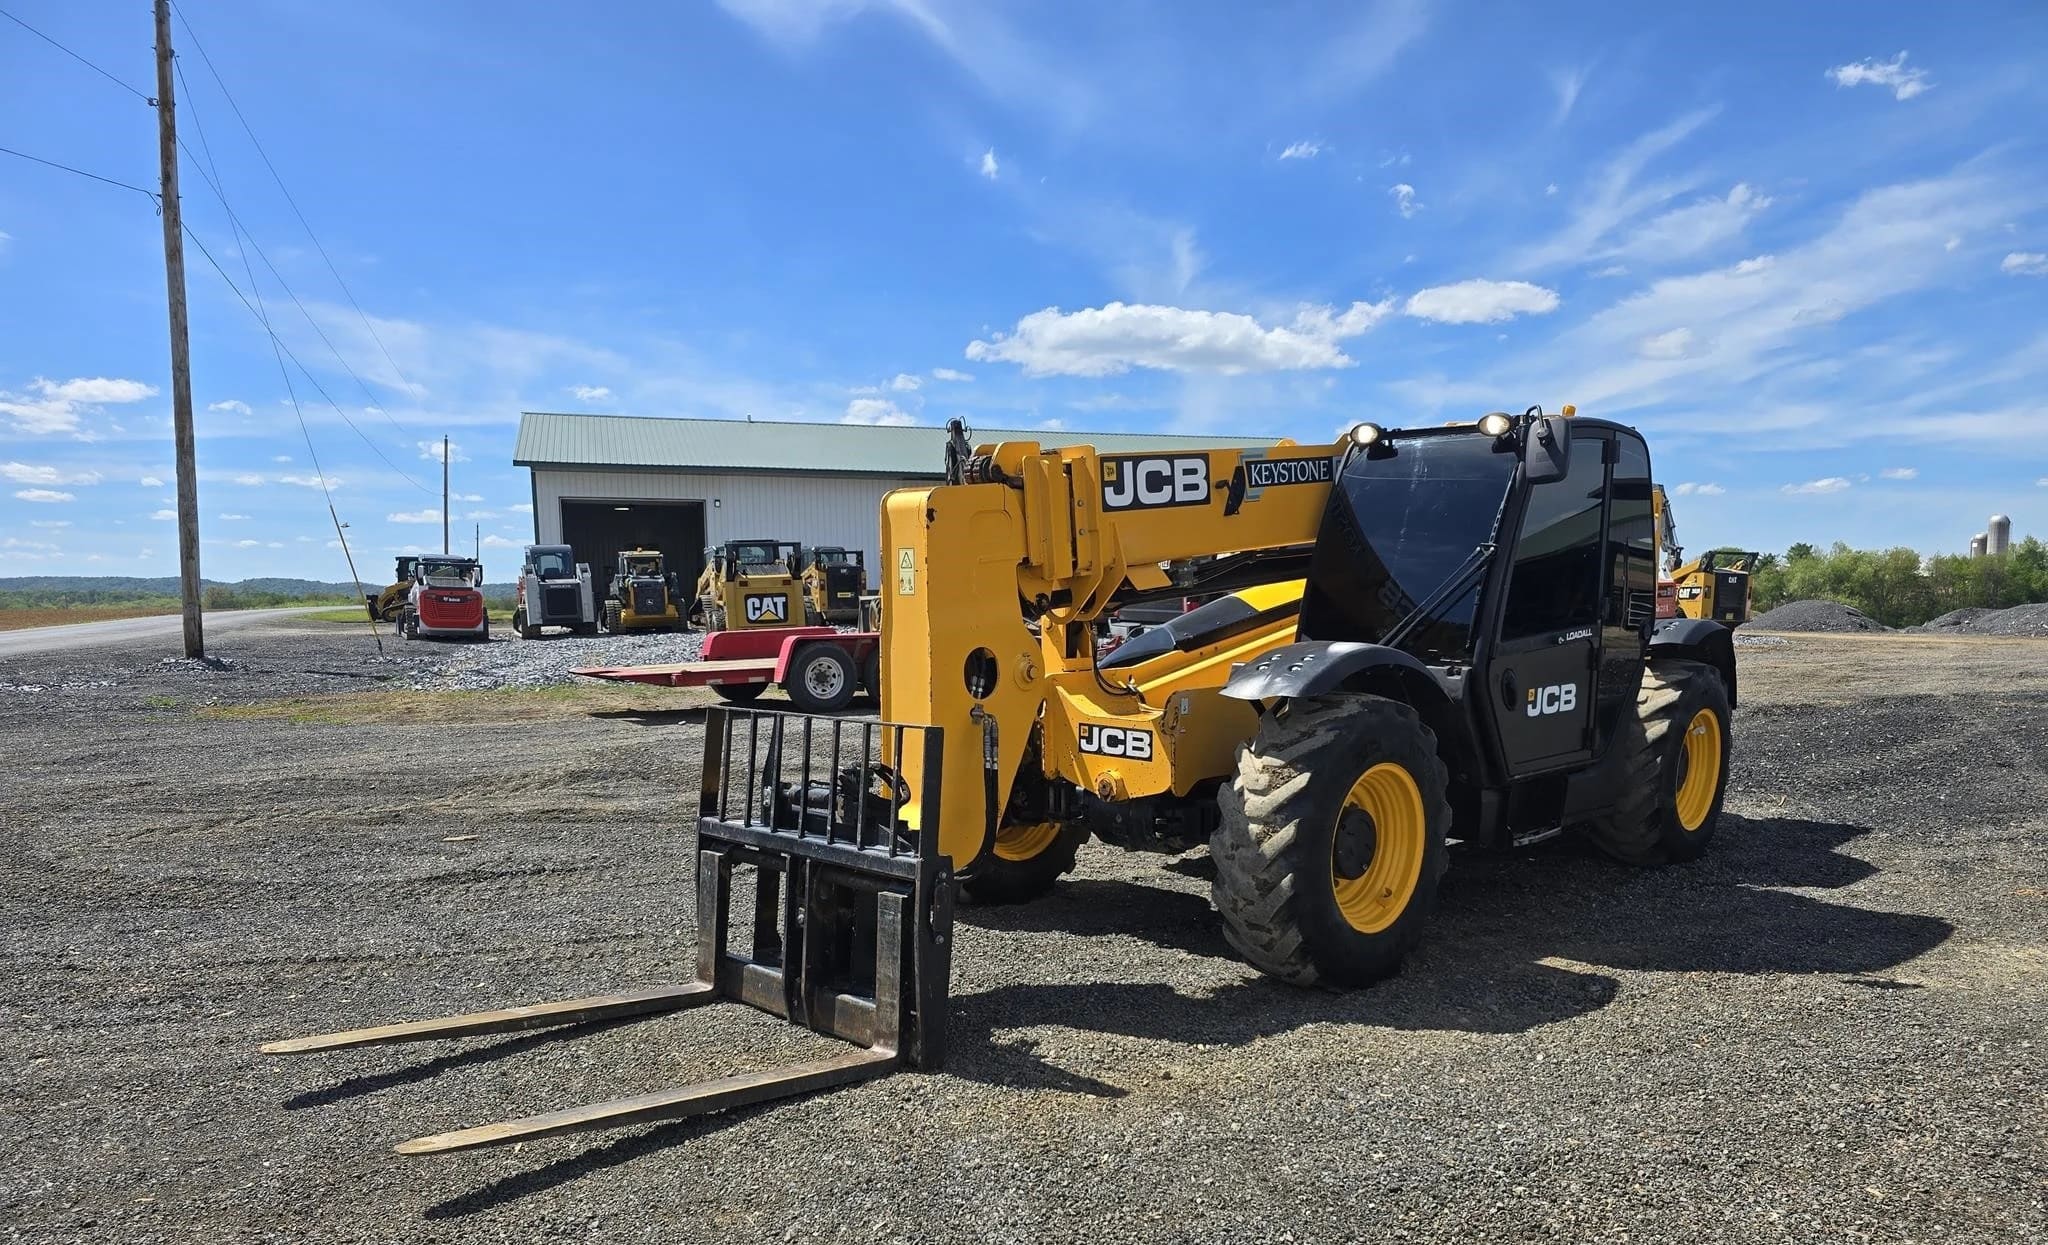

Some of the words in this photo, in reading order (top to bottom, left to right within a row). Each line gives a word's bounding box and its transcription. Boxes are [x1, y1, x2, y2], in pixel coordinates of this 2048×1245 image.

[1104, 459, 1208, 507] JCB
[1251, 460, 1329, 485] KEYSTONE
[747, 597, 786, 620] CAT
[1566, 628, 1593, 640] LOADALL
[1527, 683, 1577, 717] JCB
[1080, 726, 1151, 758] JCB
